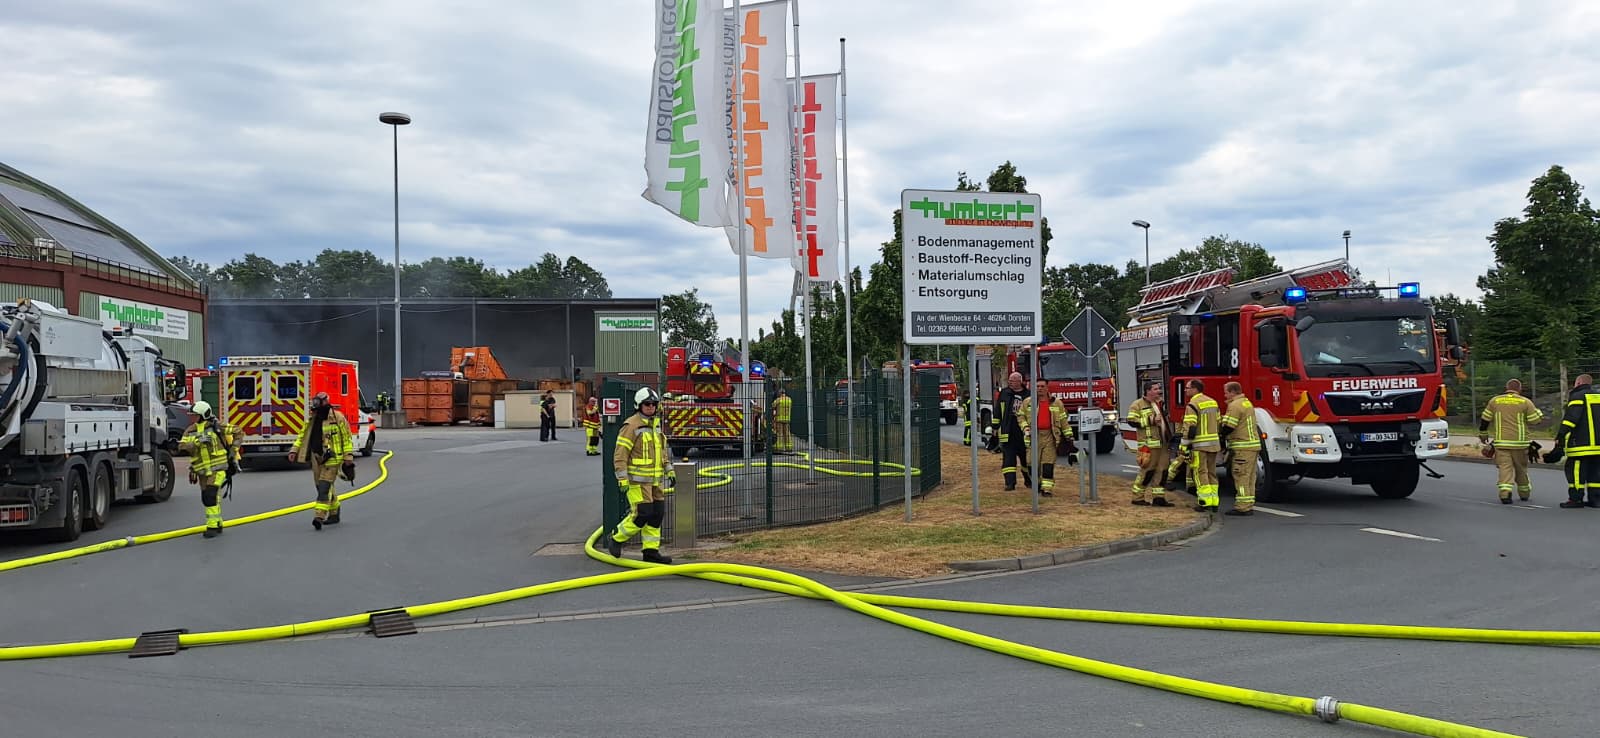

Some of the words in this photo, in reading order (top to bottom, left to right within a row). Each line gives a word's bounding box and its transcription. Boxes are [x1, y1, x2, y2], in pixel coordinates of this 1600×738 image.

[910, 197, 1034, 220] humbert
[918, 236, 1034, 250] Bodenmanagement
[918, 253, 1031, 267] Baustoff-Recycling
[918, 269, 1025, 284] Materialumschlag
[918, 286, 988, 300] Entsorgung
[102, 299, 164, 325] humbert
[917, 314, 925, 322] An
[927, 314, 937, 322] der
[1008, 314, 1031, 322] Dorsten
[602, 319, 652, 327] humbert
[981, 324, 1031, 333] www.humbert.de
[1231, 347, 1239, 368] 8
[1333, 378, 1417, 391] FEUERWEHR
[1361, 402, 1394, 410] MAN
